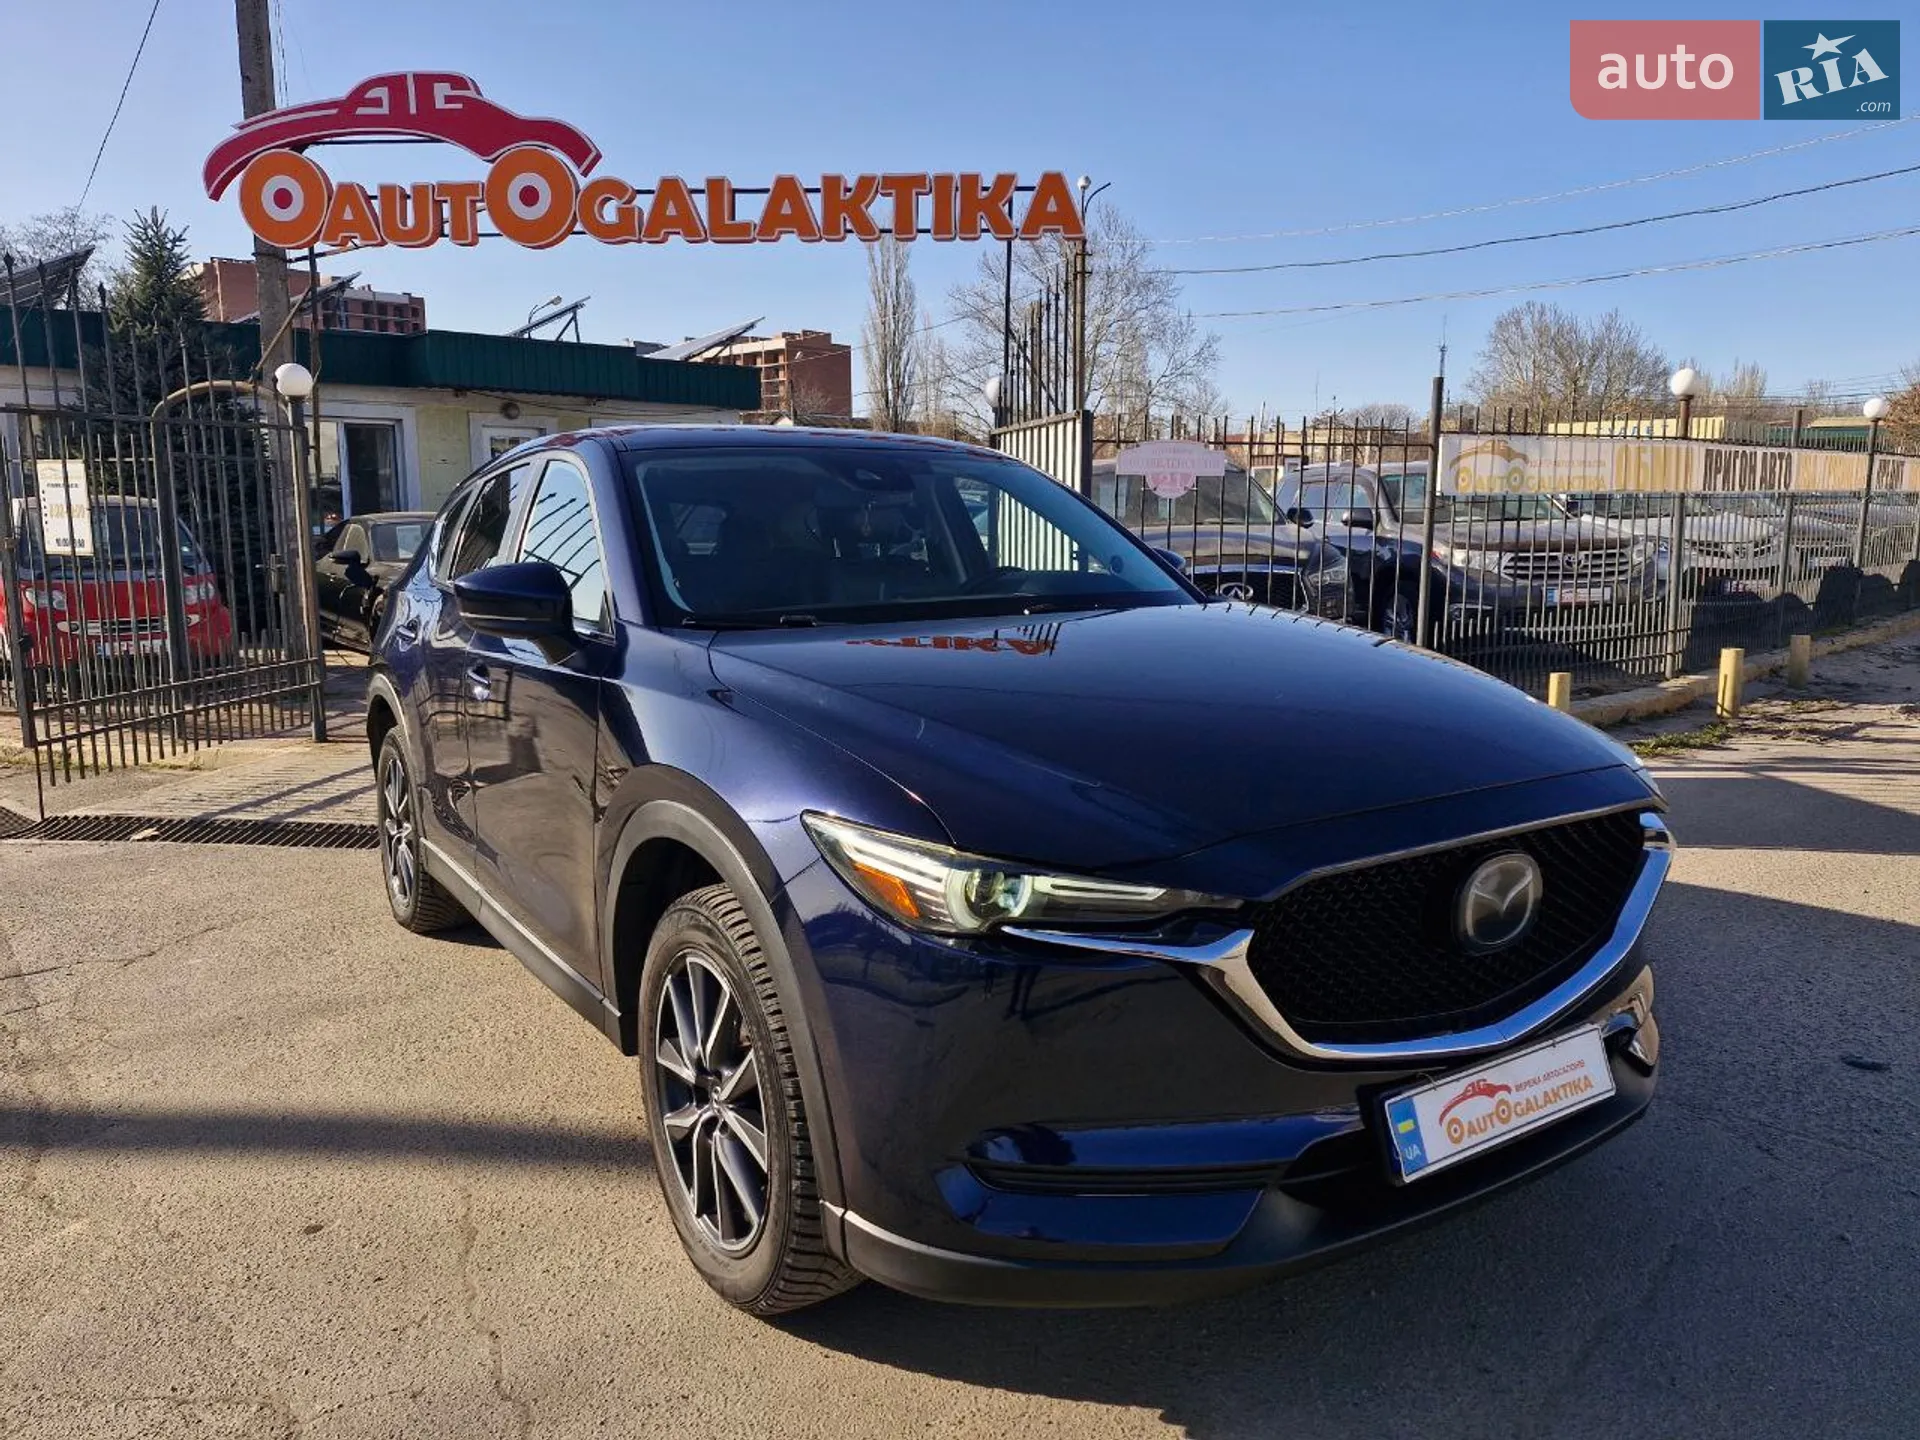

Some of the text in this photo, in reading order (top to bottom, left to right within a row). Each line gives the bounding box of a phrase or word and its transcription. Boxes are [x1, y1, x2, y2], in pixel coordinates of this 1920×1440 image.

[1703, 448, 1758, 491] ПРИГОН
[1760, 451, 1793, 490] АВТО
[1404, 1144, 1422, 1160] UA
